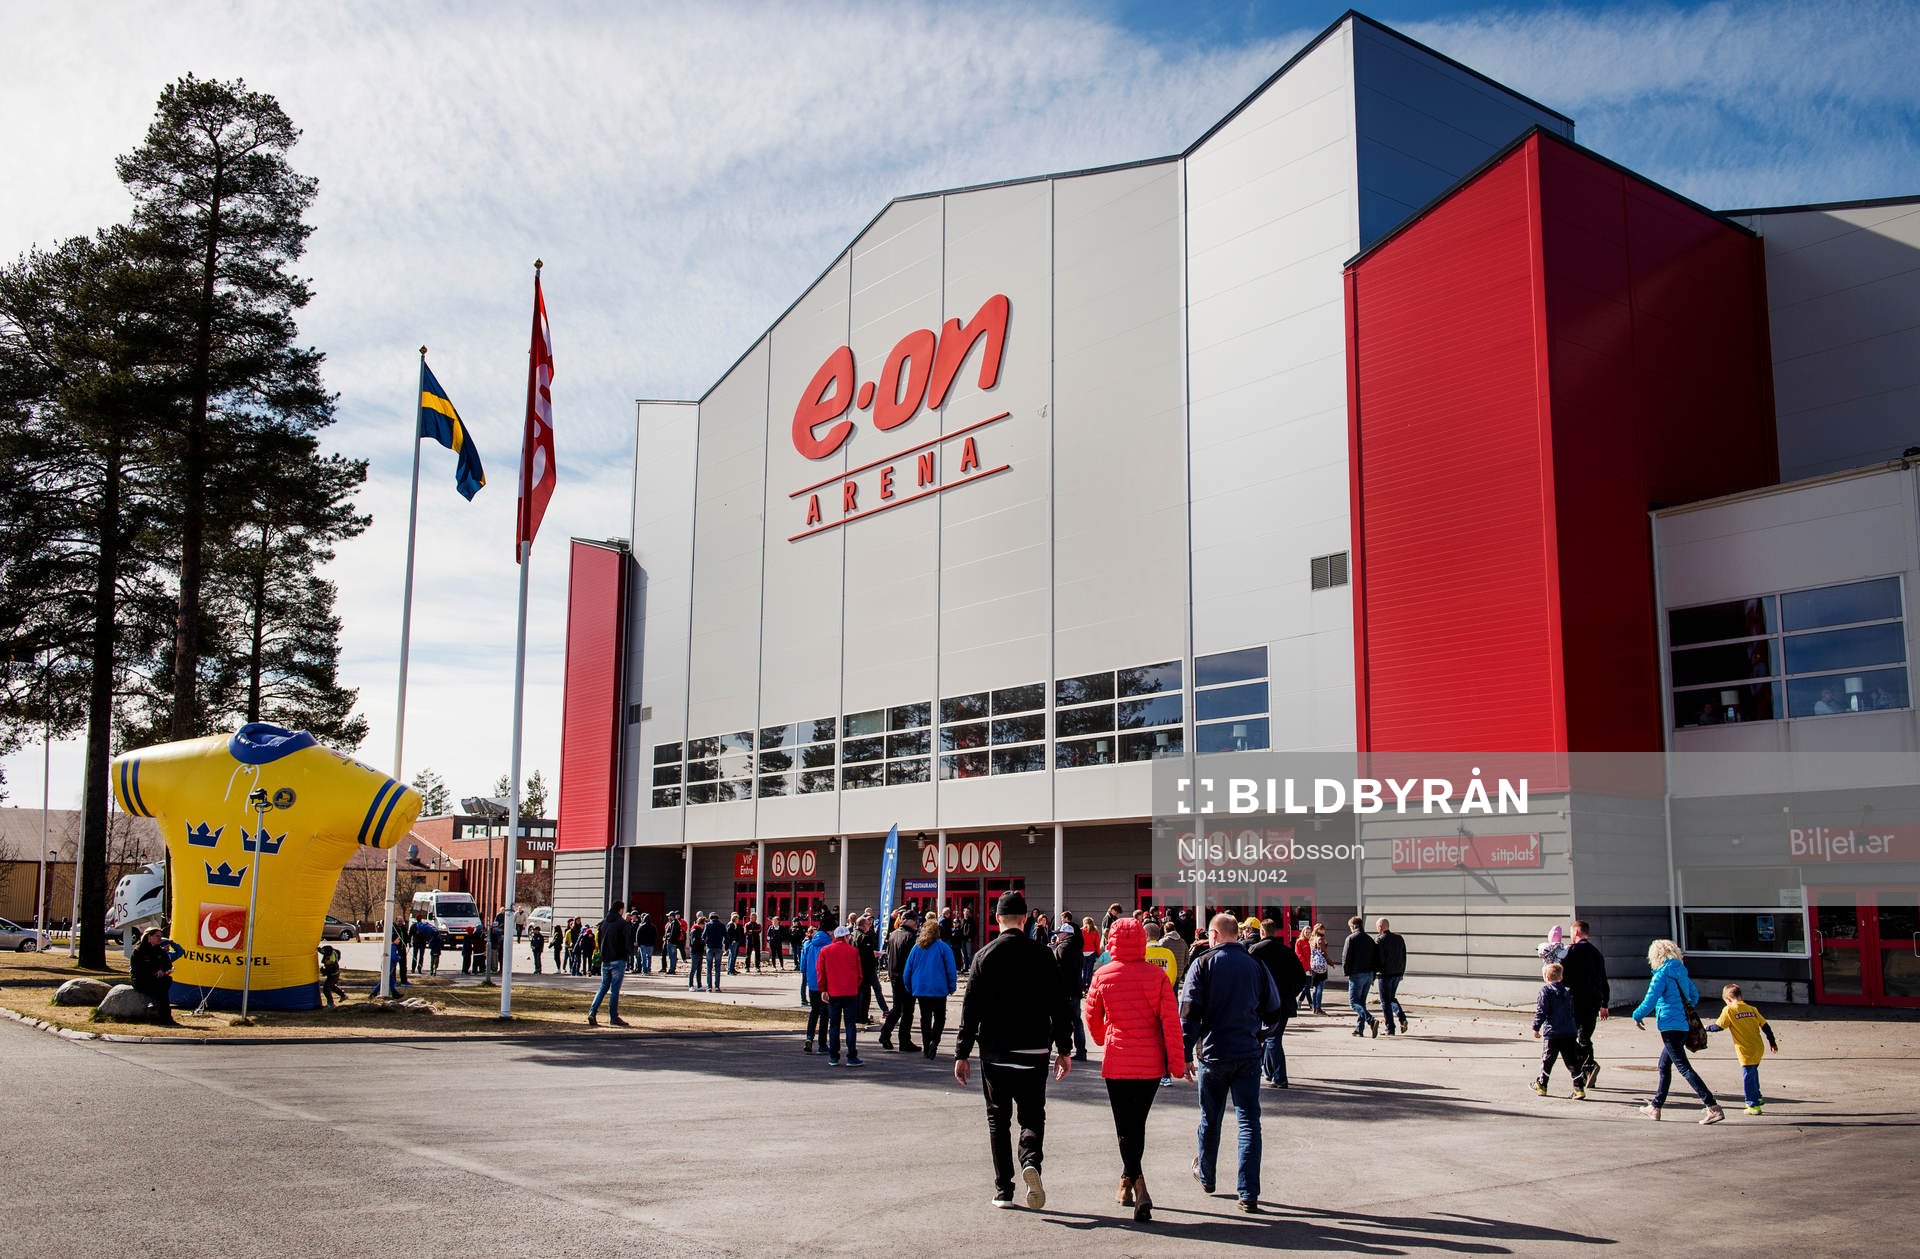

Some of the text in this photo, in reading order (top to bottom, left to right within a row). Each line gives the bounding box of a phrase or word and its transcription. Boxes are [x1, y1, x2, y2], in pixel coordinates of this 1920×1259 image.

[806, 436, 978, 526] ARENA
[526, 840, 557, 851] TIMR
[1391, 838, 1535, 870] Biljetter sittplats
[1790, 827, 1895, 861] Biljeter
[183, 949, 231, 965] VENSKA
